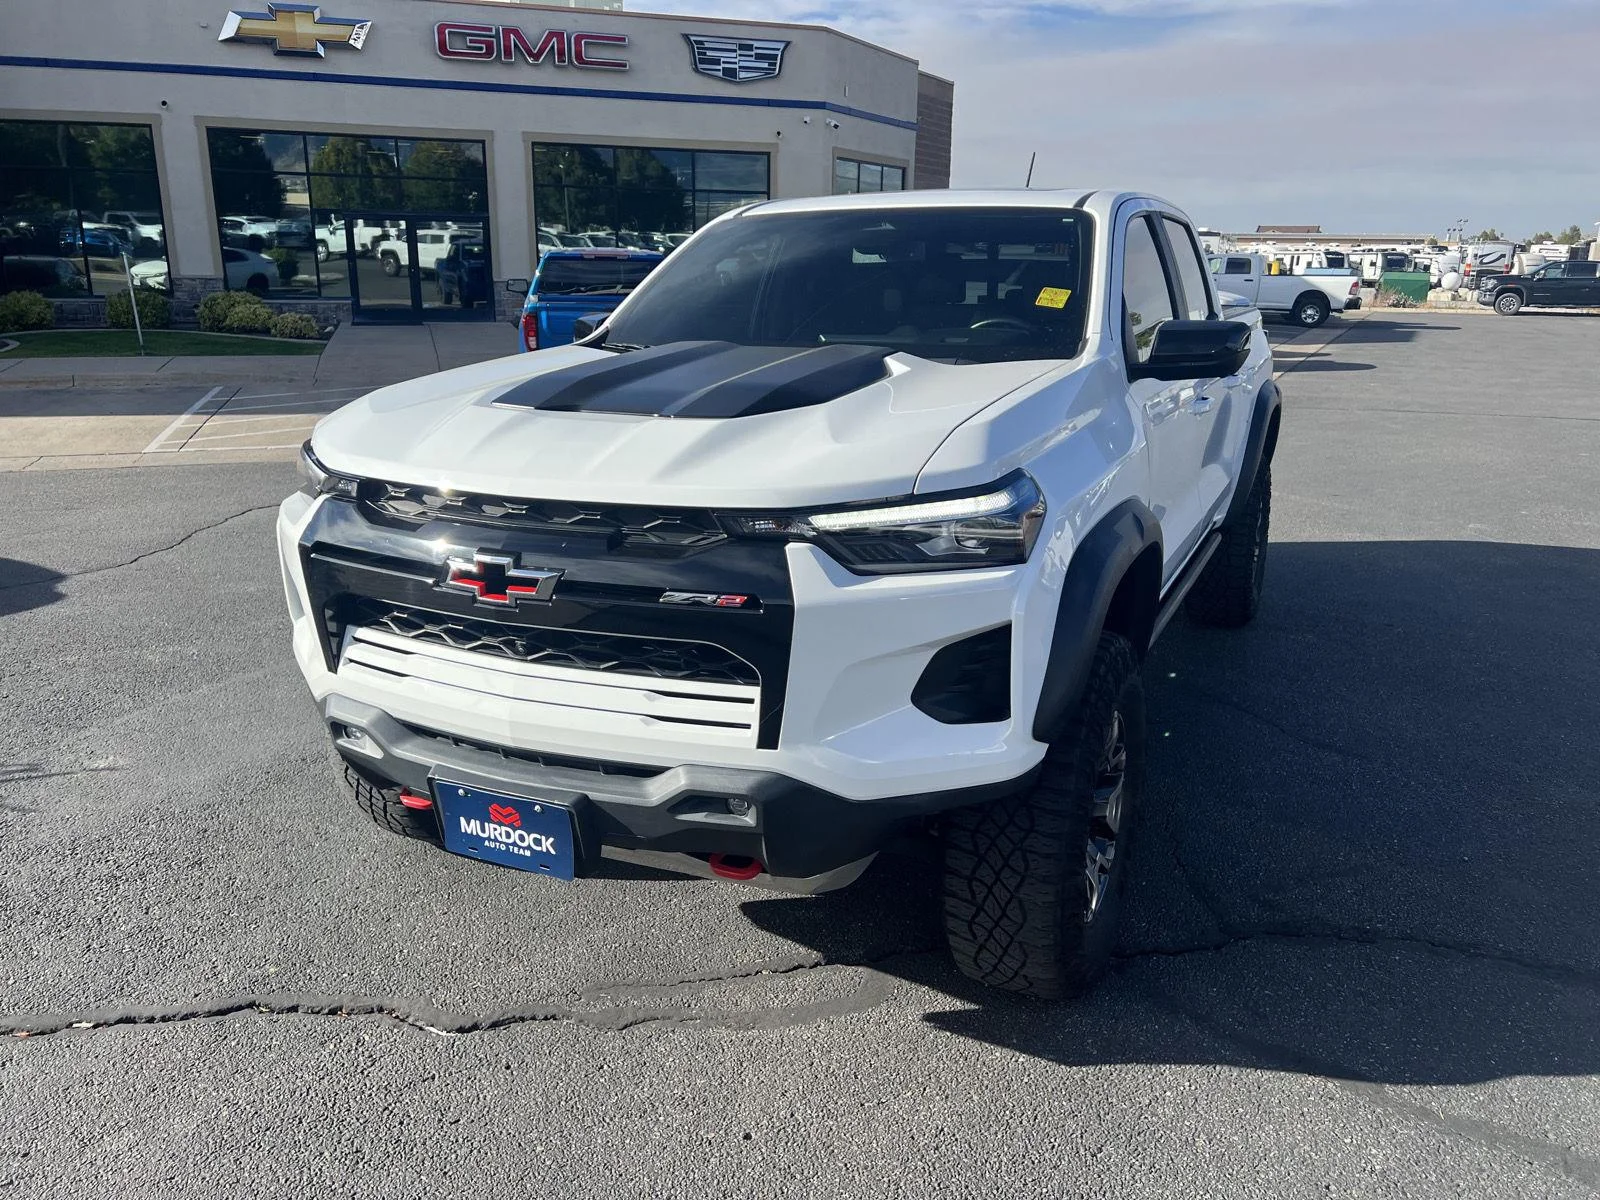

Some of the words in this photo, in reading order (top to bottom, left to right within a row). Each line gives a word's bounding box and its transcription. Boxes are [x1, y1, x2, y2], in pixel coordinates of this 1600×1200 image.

[435, 22, 629, 70] GMC
[659, 591, 748, 607] ZR2
[459, 816, 556, 854] MURDOCK
[484, 840, 506, 850] AUTO
[509, 846, 531, 856] TEAM
